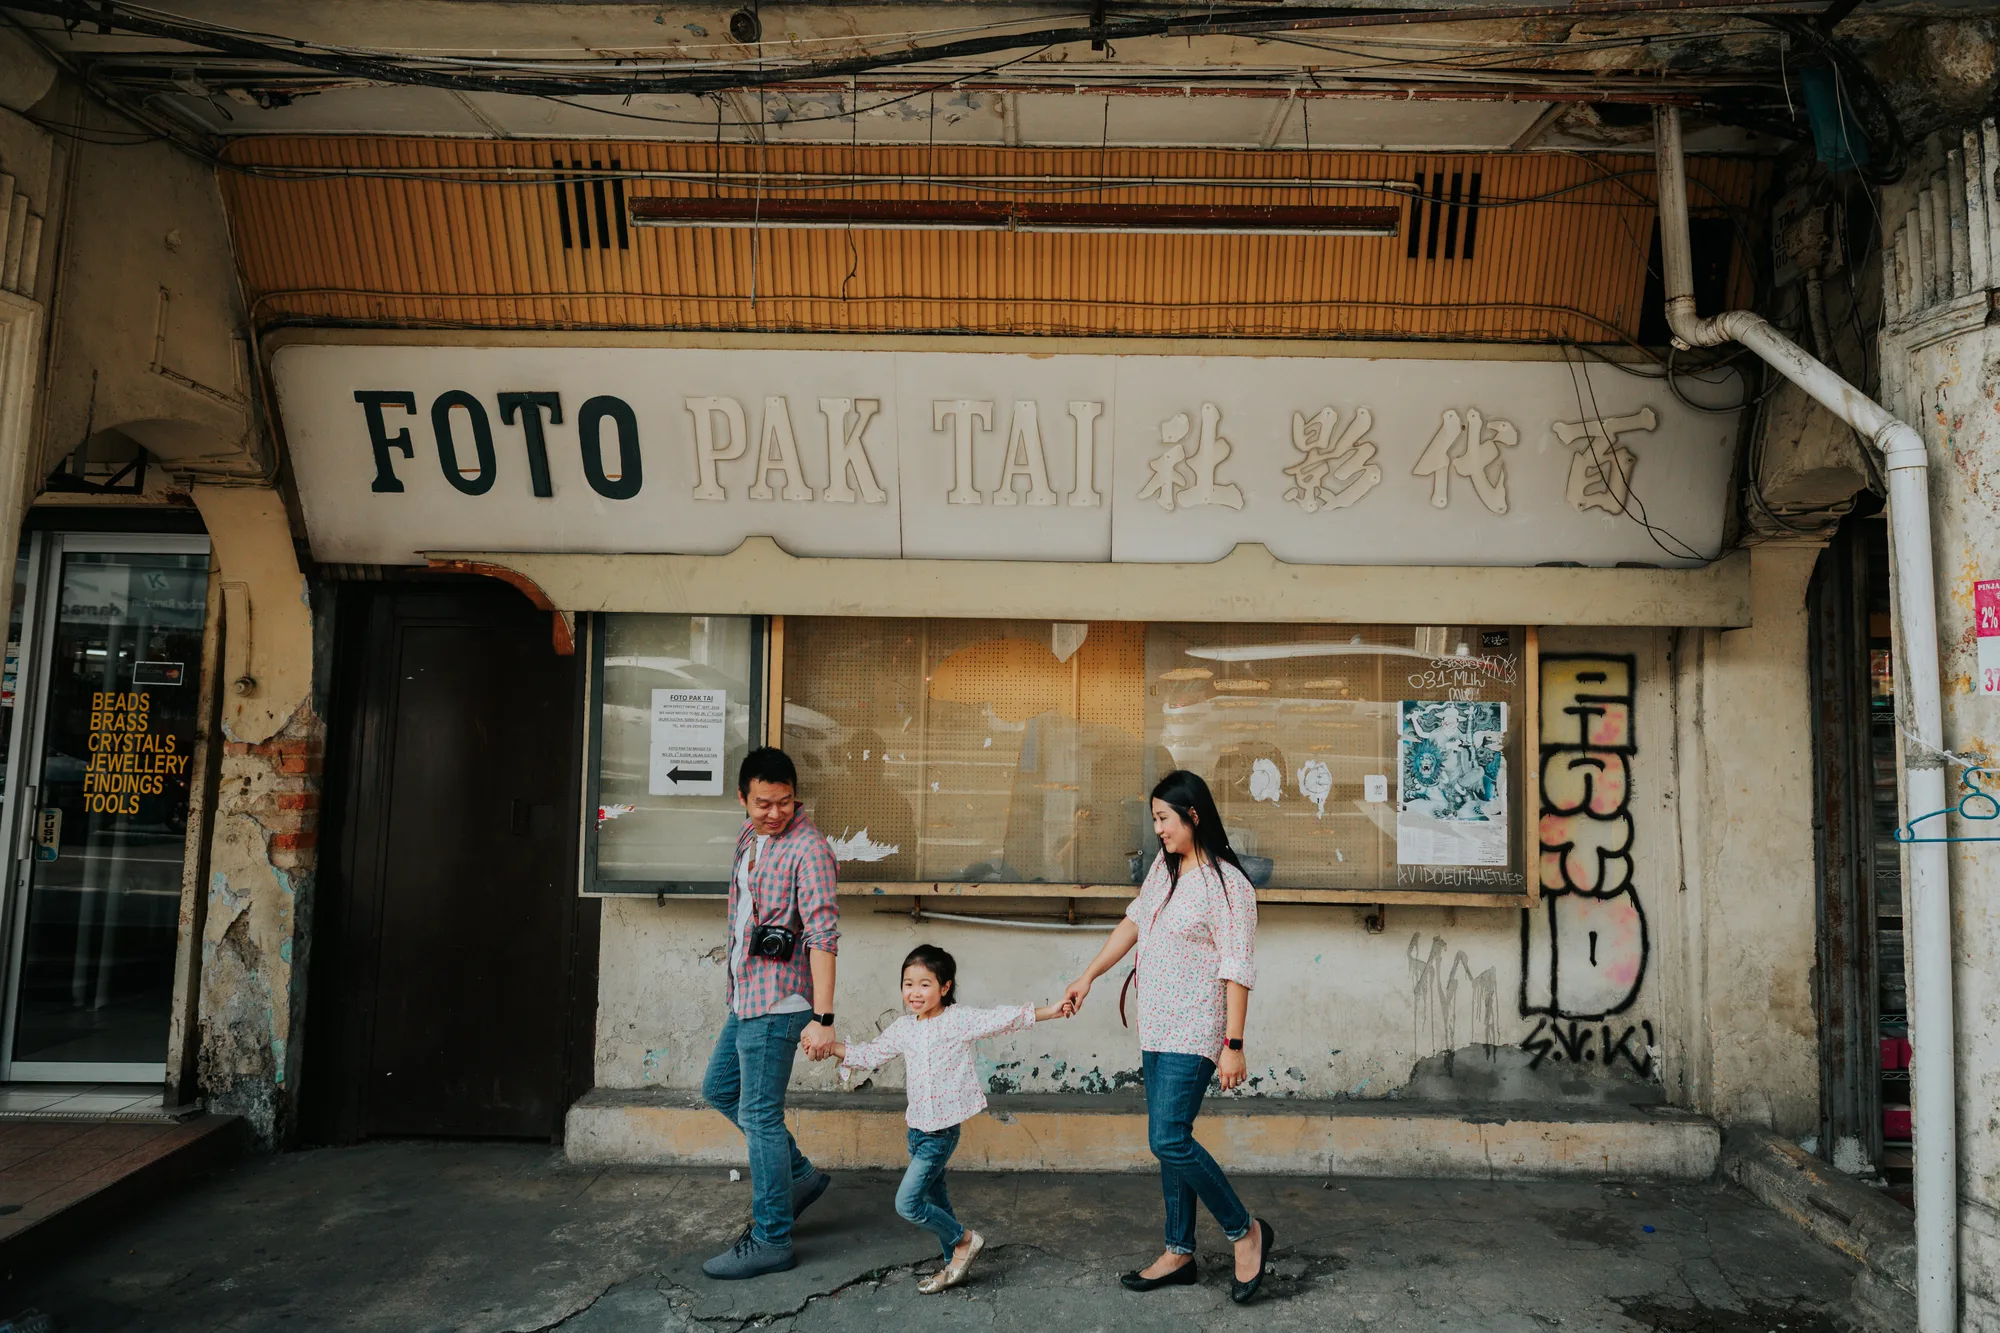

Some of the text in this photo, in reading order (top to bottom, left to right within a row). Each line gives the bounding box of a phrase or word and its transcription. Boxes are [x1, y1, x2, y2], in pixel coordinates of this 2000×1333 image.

[354, 388, 1104, 507] FOTO PAK TAI
[1981, 606, 1999, 630] 2%
[92, 692, 150, 712] BEADS
[670, 694, 688, 702] FOTO
[689, 695, 702, 703] PAK
[89, 712, 149, 732] BRASS
[88, 733, 176, 754] CRYSTALS
[85, 754, 190, 775] JEWELLERY
[83, 773, 164, 795] FINDINGS
[83, 793, 140, 815] TOOLS
[43, 814, 55, 843] PUSH
